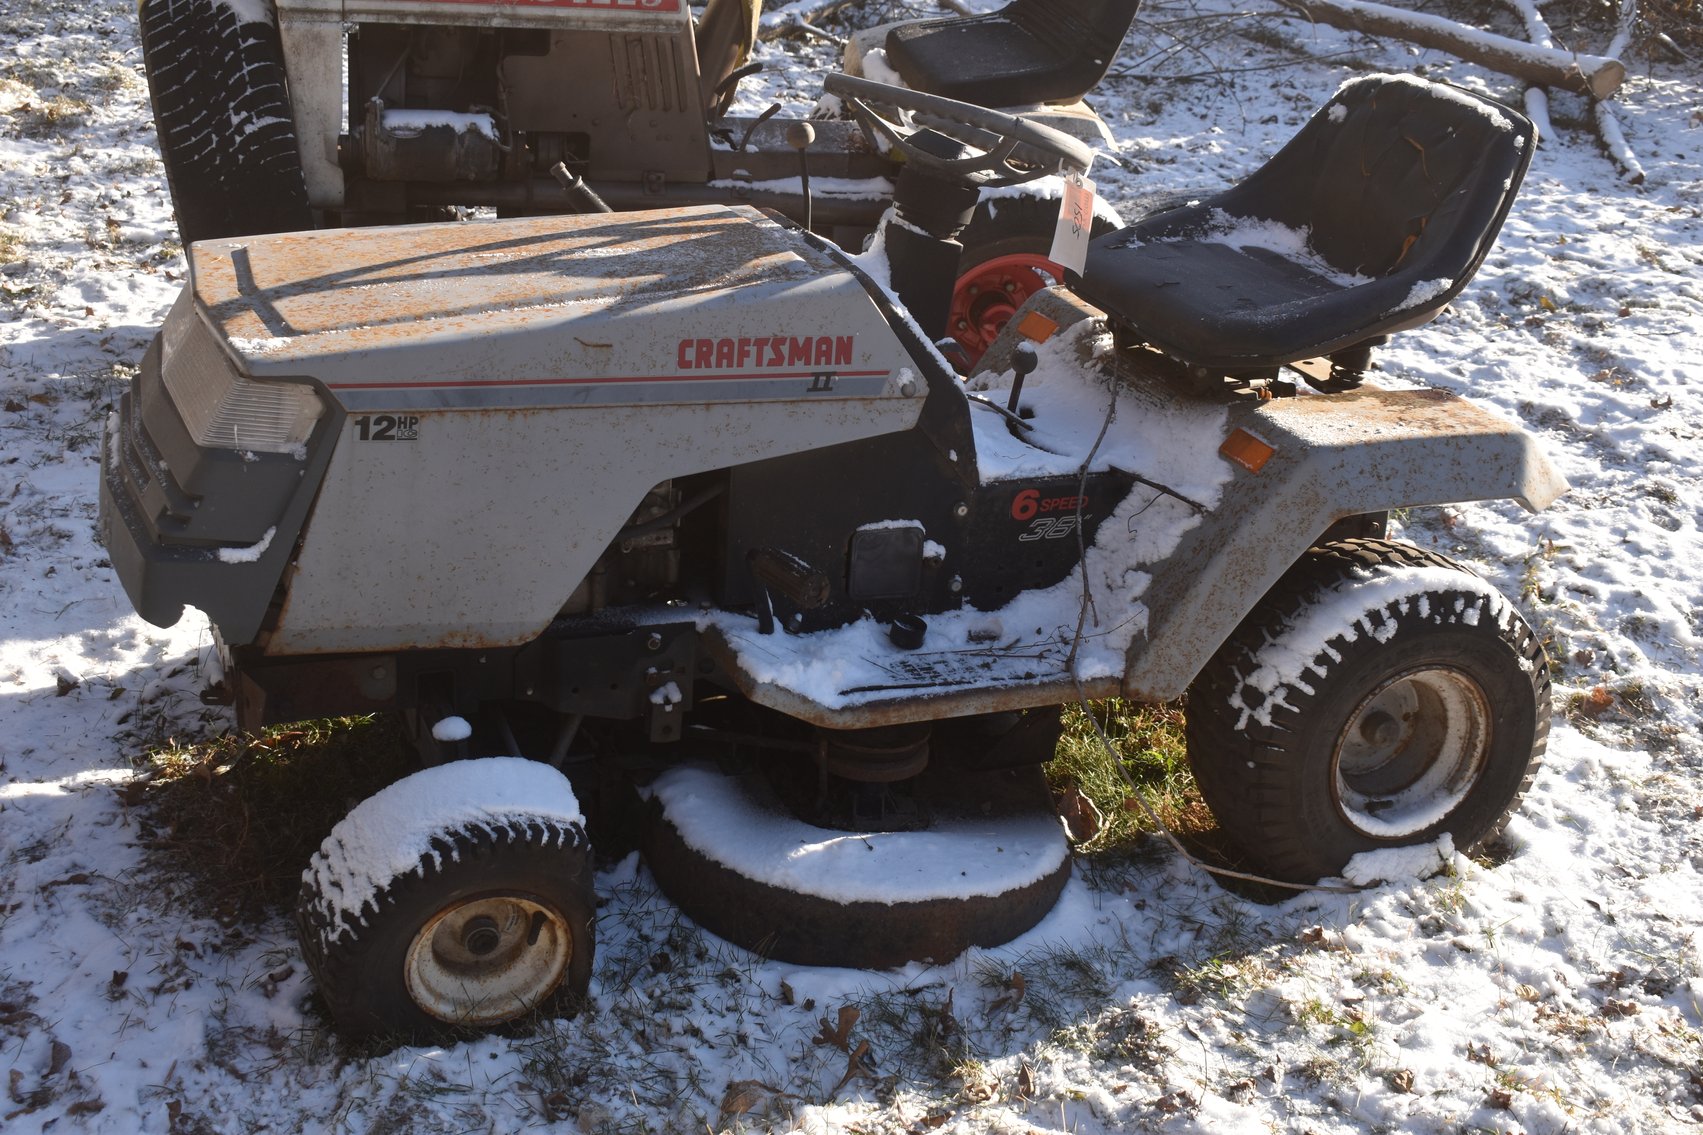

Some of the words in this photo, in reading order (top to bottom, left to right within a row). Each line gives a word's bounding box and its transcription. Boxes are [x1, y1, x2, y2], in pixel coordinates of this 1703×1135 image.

[677, 335, 854, 370] CRAFTSMAN
[806, 371, 838, 393] II
[354, 415, 397, 441] 12
[397, 416, 419, 430] HP
[1011, 488, 1041, 521] 6
[1039, 495, 1089, 512] SPEED
